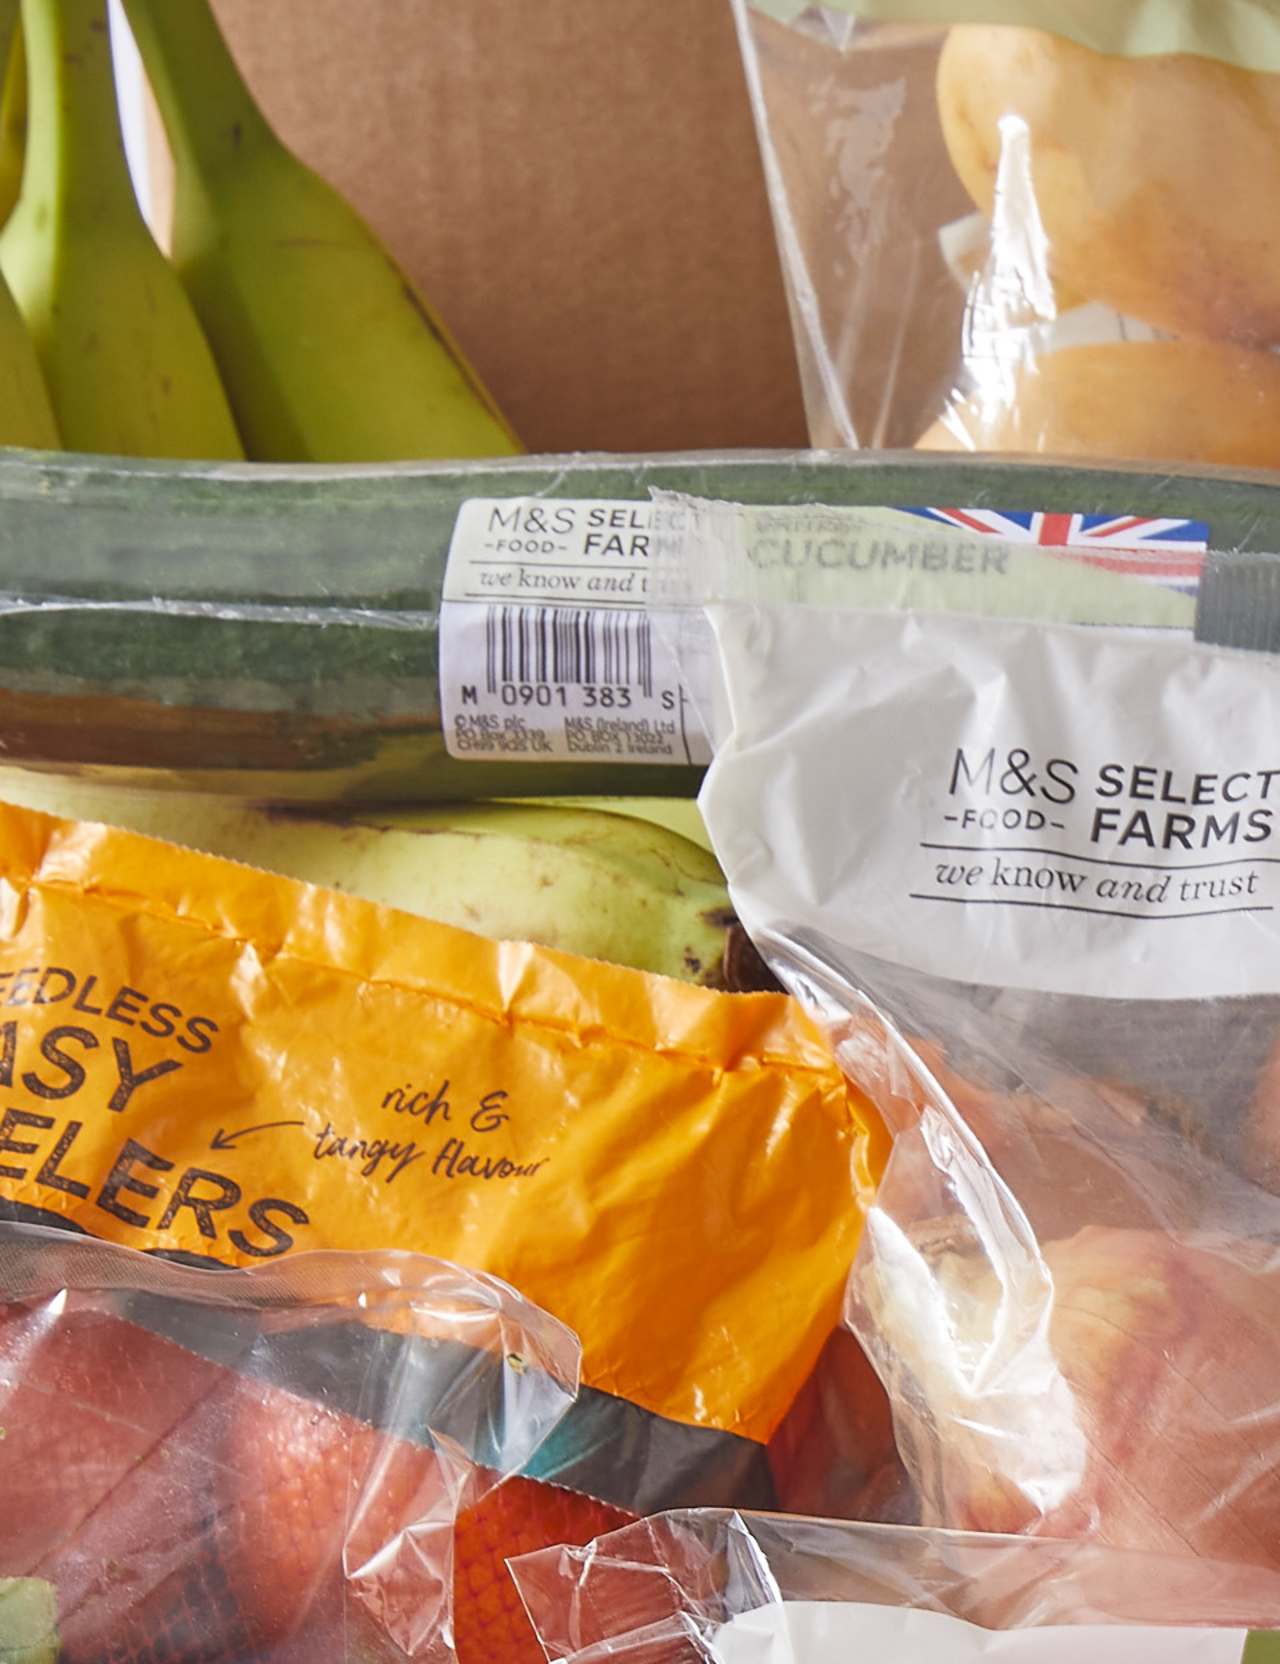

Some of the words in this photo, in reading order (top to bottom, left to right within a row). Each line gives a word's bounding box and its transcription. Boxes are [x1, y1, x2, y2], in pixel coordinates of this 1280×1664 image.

[488, 507, 576, 533] M&S
[751, 539, 1012, 575] CUCUMBER
[479, 571, 513, 587] we
[518, 569, 581, 591] know
[587, 573, 635, 593] and
[461, 685, 478, 705] M
[502, 685, 567, 706] 0901
[583, 686, 633, 707] 383
[662, 690, 675, 709] S
[948, 747, 1080, 805] M&S
[1089, 806, 1274, 852] FARMS
[936, 861, 984, 887] we
[989, 857, 1087, 895] know
[1096, 875, 1173, 904] and
[1178, 870, 1259, 902] trust
[381, 1079, 452, 1126] rich
[470, 1090, 510, 1132] &
[313, 1122, 425, 1184] tangy
[432, 1137, 551, 1179] flavour
